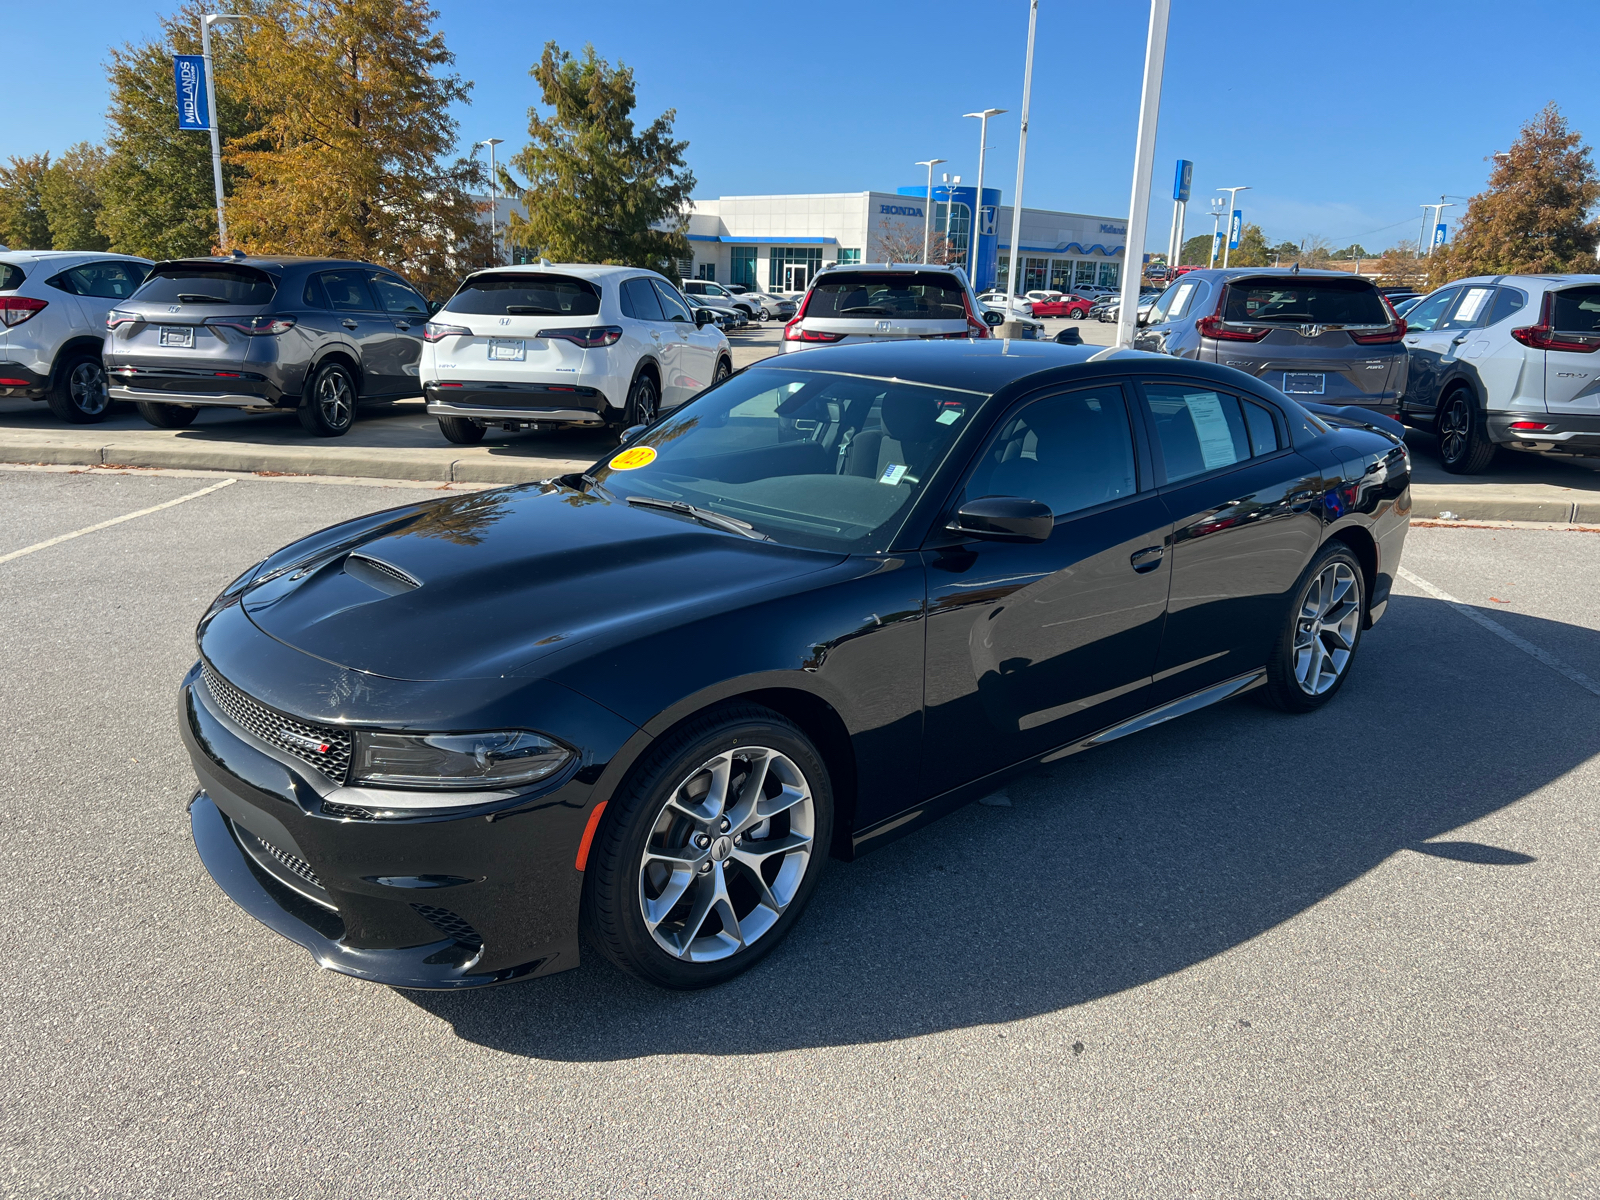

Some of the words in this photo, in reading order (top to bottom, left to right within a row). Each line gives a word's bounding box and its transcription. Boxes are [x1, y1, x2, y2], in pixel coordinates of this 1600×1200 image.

[180, 61, 195, 123] MIDLANDS
[880, 204, 924, 217] HONDA
[280, 731, 321, 750] DODGE
